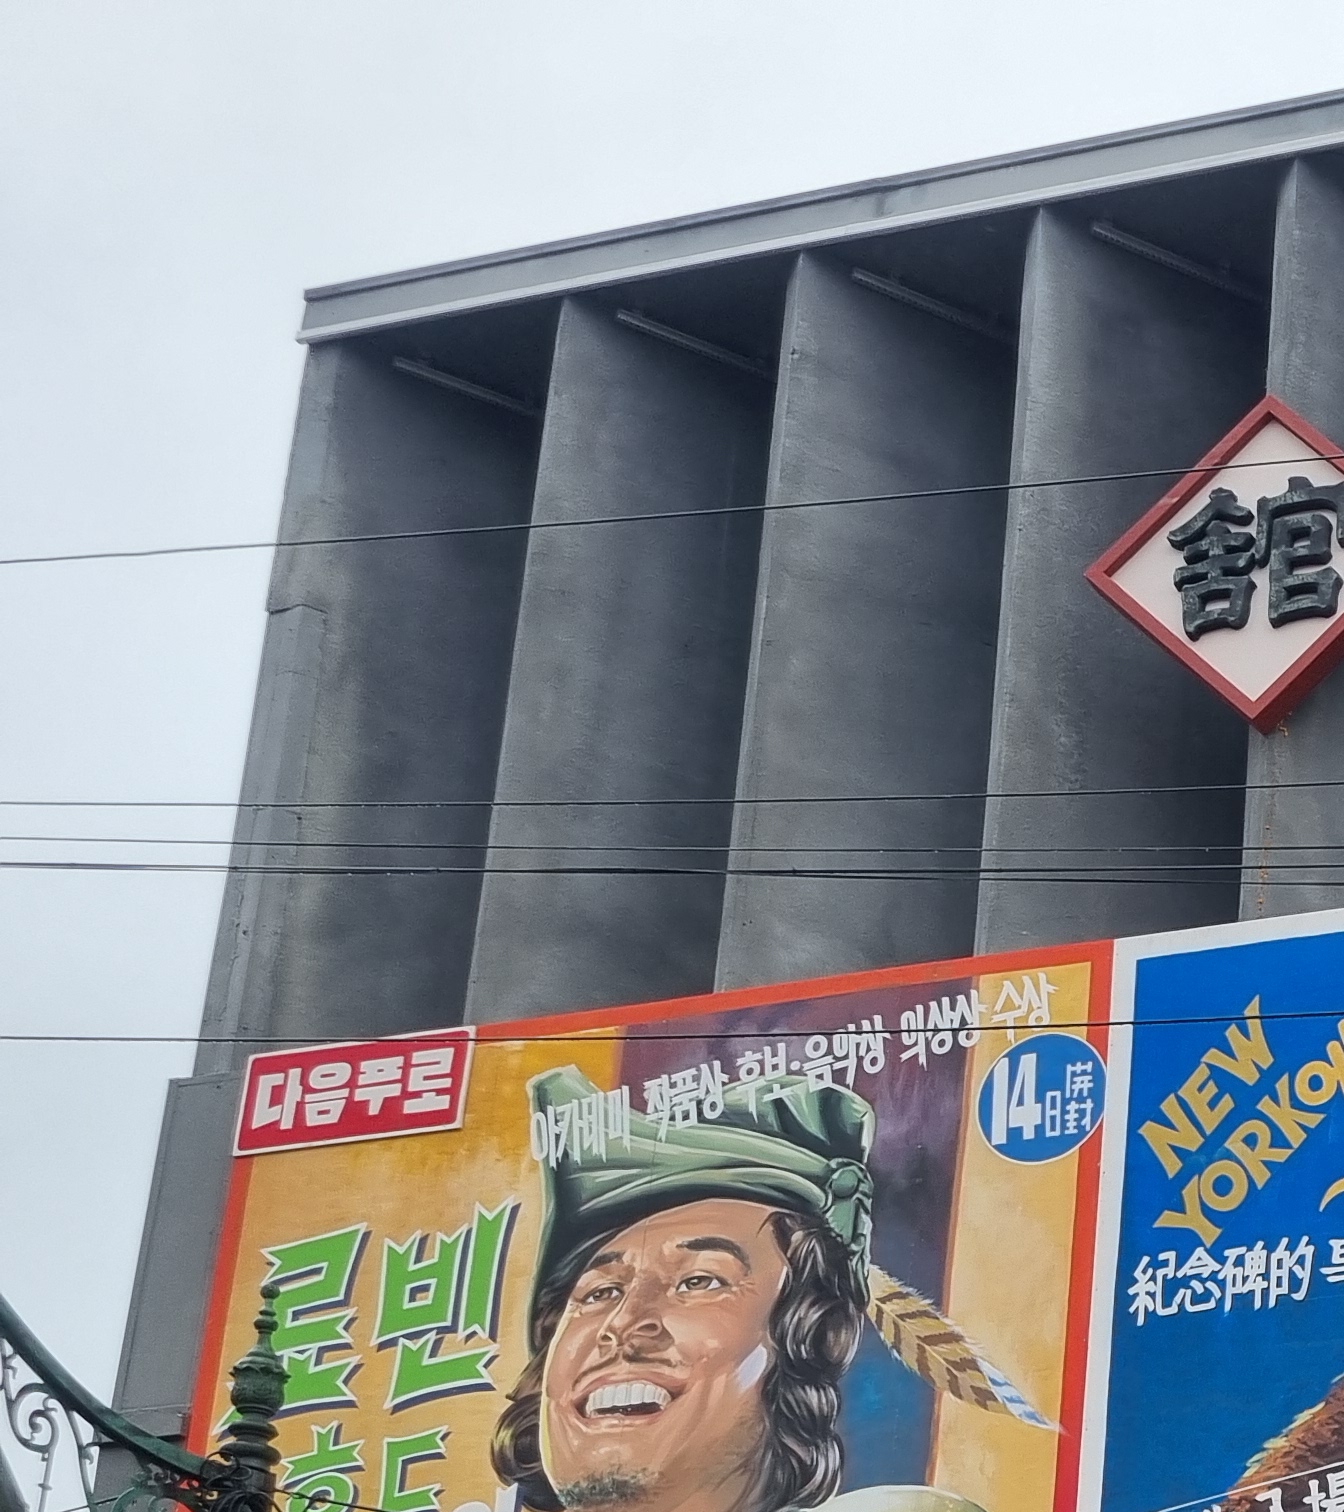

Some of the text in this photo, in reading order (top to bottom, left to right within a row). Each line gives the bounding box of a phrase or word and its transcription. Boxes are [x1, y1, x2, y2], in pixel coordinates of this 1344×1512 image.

[991, 972, 1059, 1042] 수상
[251, 1047, 455, 1131] 다음푸로
[1137, 995, 1279, 1180] NEW
[1127, 1236, 1315, 1326] 紀念碑的
